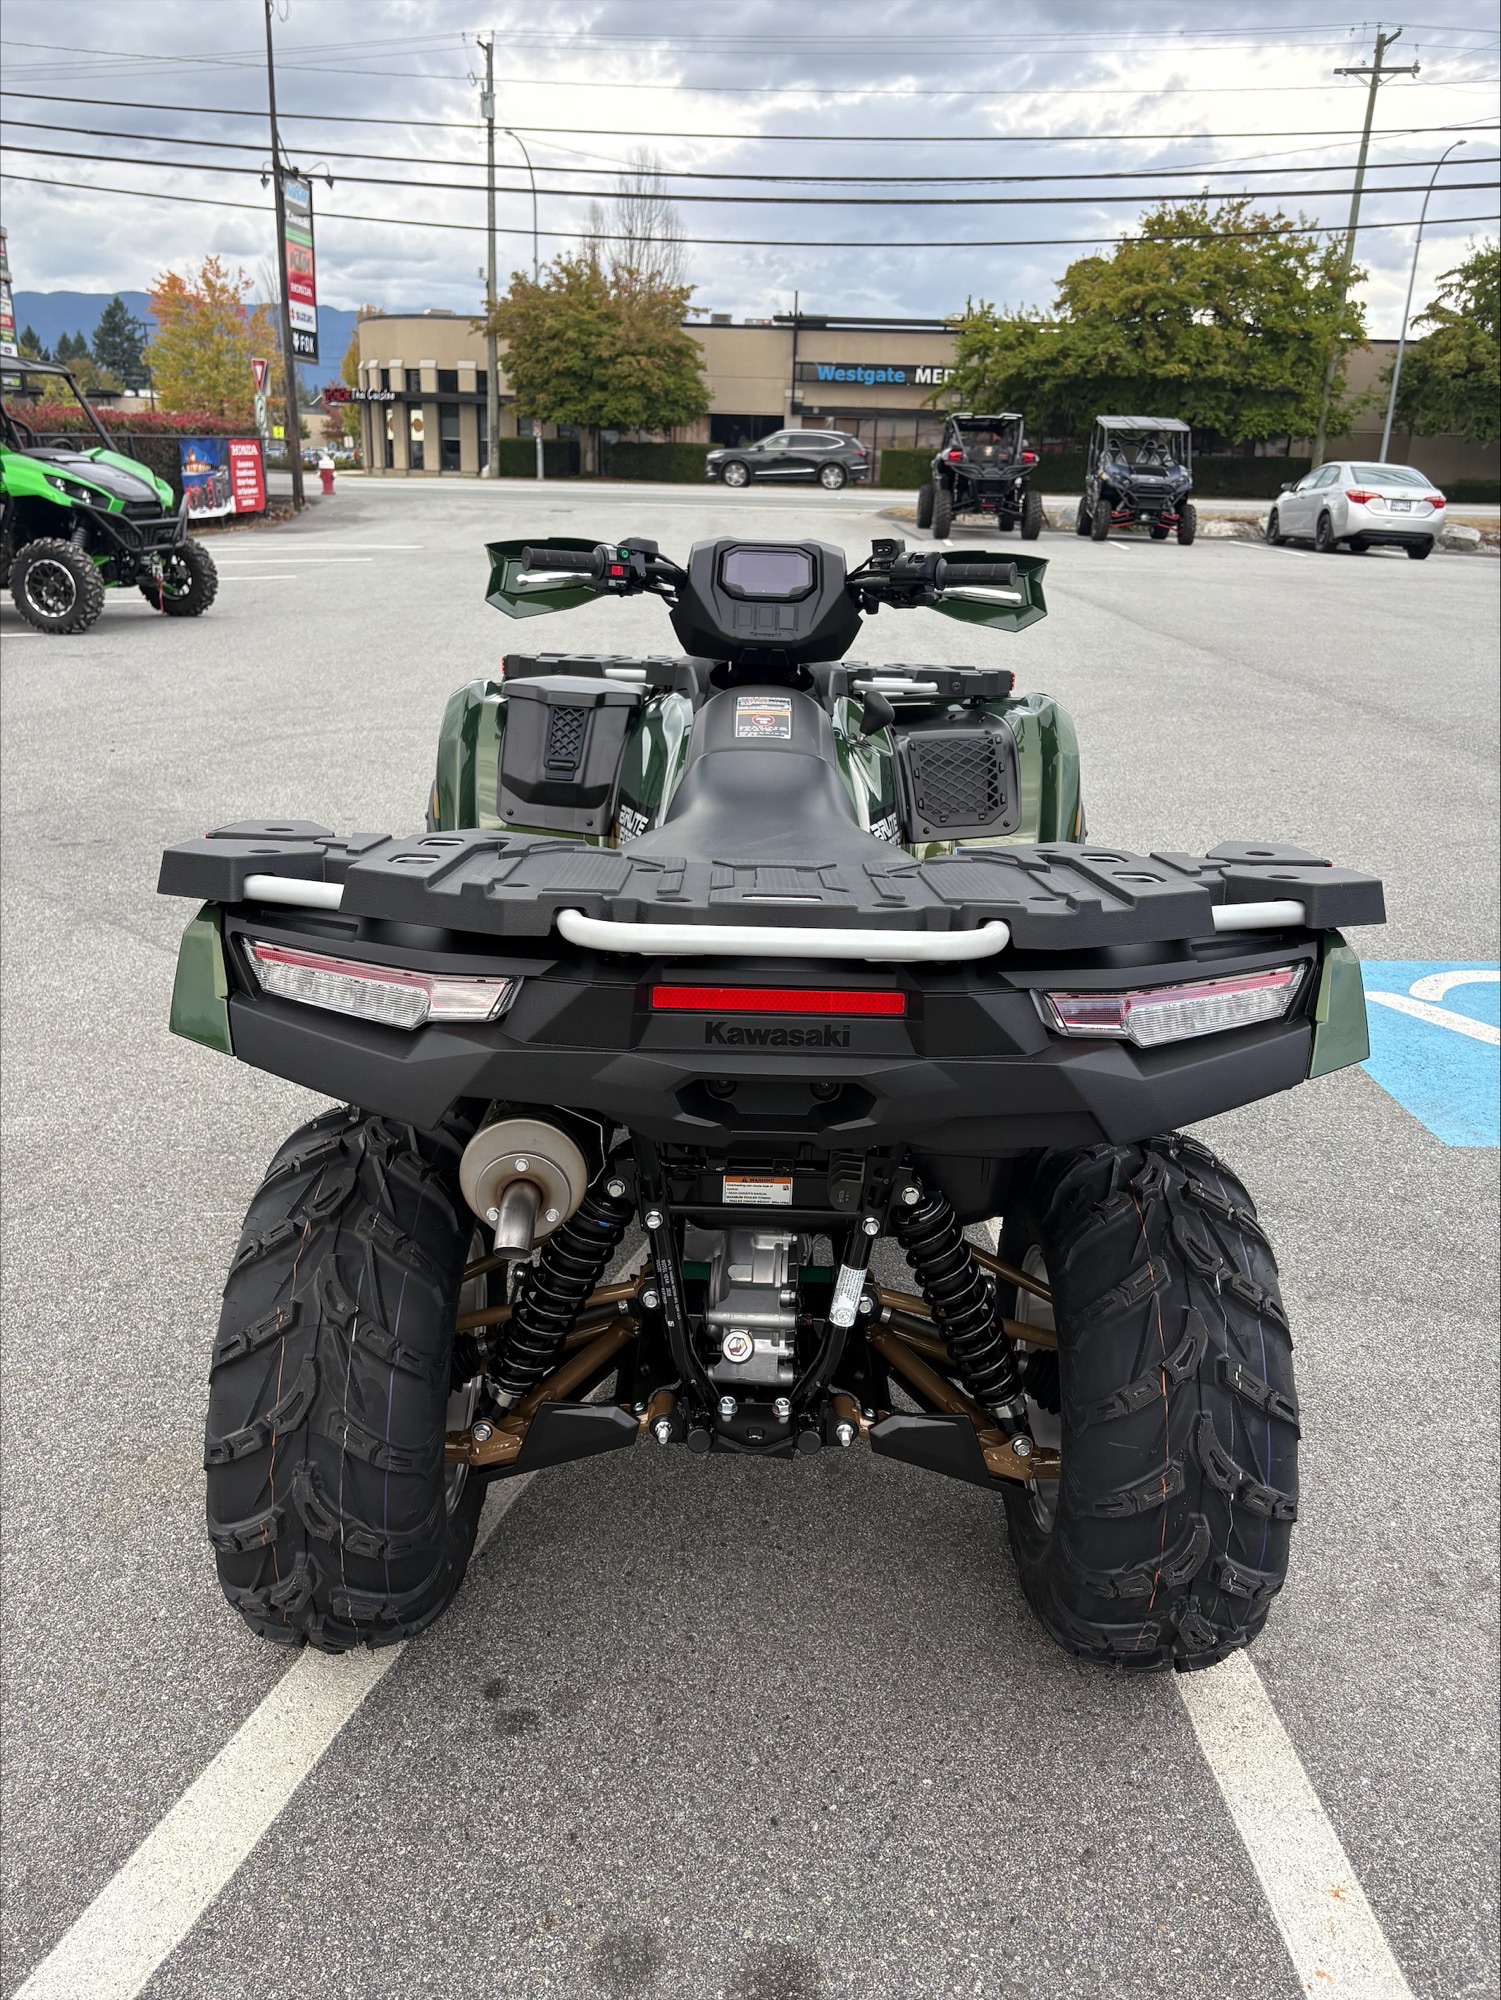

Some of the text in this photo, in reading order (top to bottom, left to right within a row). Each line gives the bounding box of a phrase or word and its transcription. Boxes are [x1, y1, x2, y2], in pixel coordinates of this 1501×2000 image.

[290, 248, 310, 274] KTM
[290, 282, 312, 298] HONDA
[295, 310, 313, 324] SUZUKI
[299, 334, 315, 353] FOX
[816, 364, 960, 386] Westgate MED
[351, 388, 366, 400] Thai
[367, 387, 396, 401] Cuisine
[231, 444, 258, 456] HONDA
[618, 804, 649, 836] BRUTE
[869, 812, 899, 841] BRUTE
[704, 1021, 851, 1048] Kawasaki
